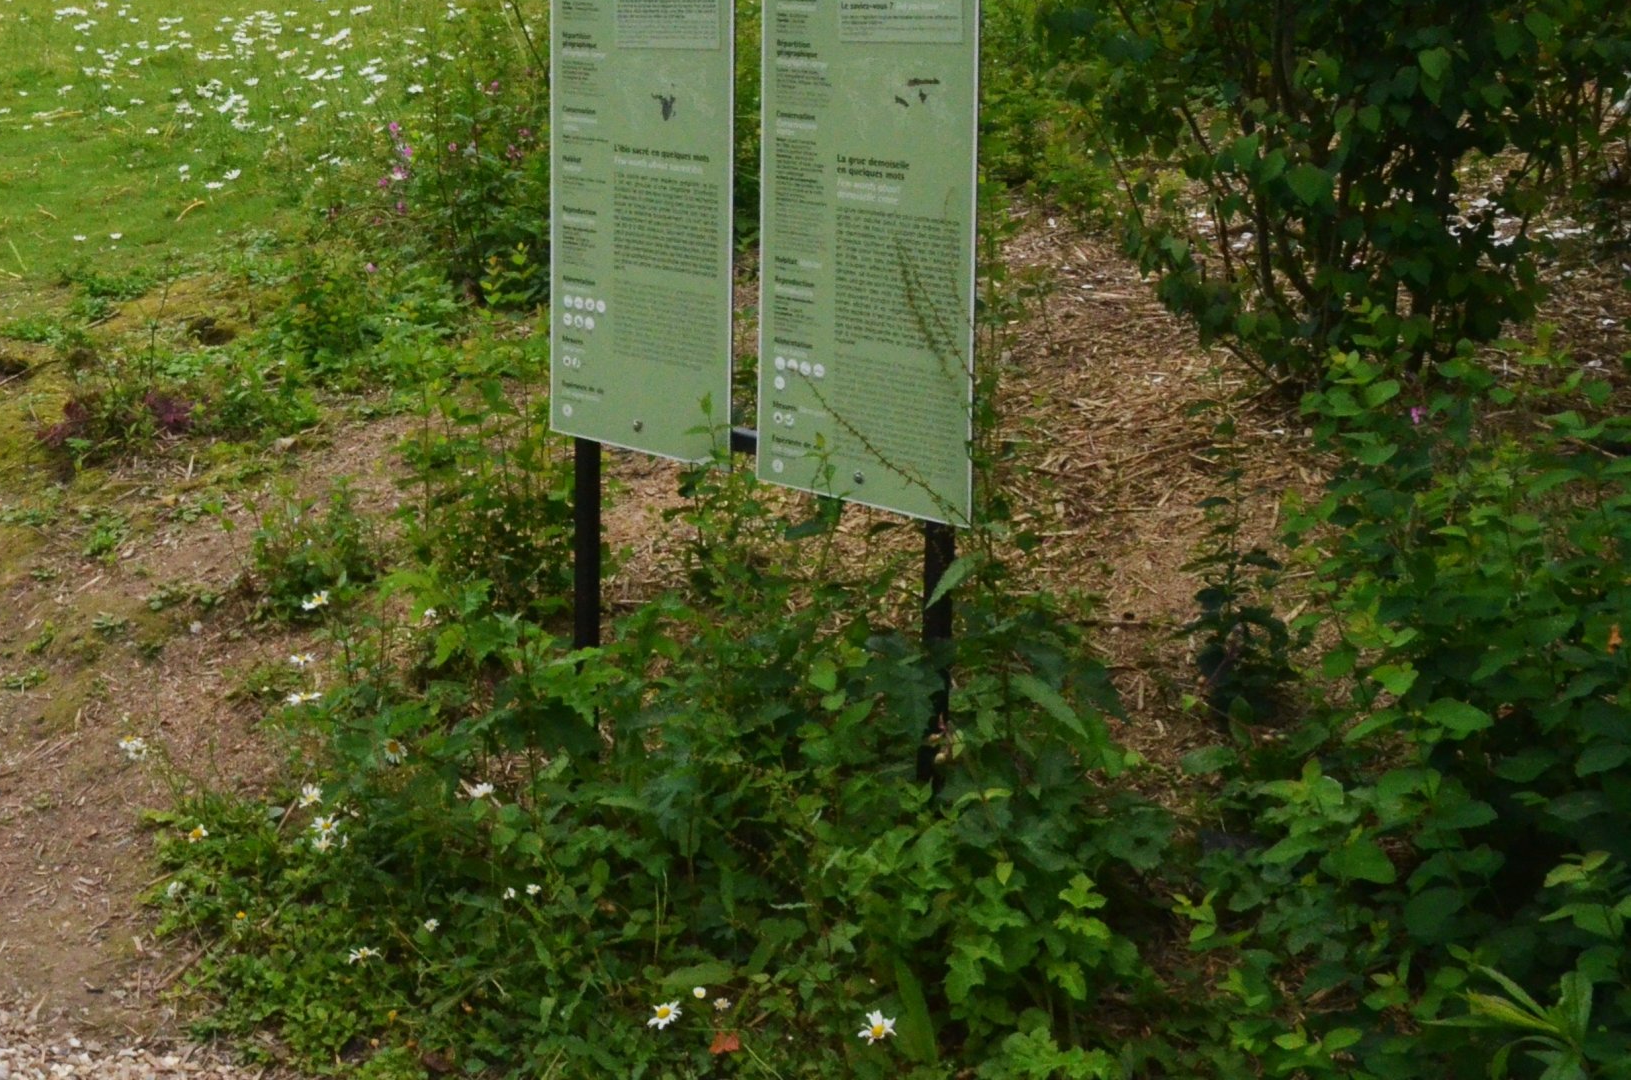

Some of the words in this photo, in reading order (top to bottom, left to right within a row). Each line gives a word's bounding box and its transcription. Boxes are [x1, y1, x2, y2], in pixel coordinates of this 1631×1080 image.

[836, 154, 846, 163] La
[848, 157, 866, 166] grue
[868, 157, 910, 170] demoiselle
